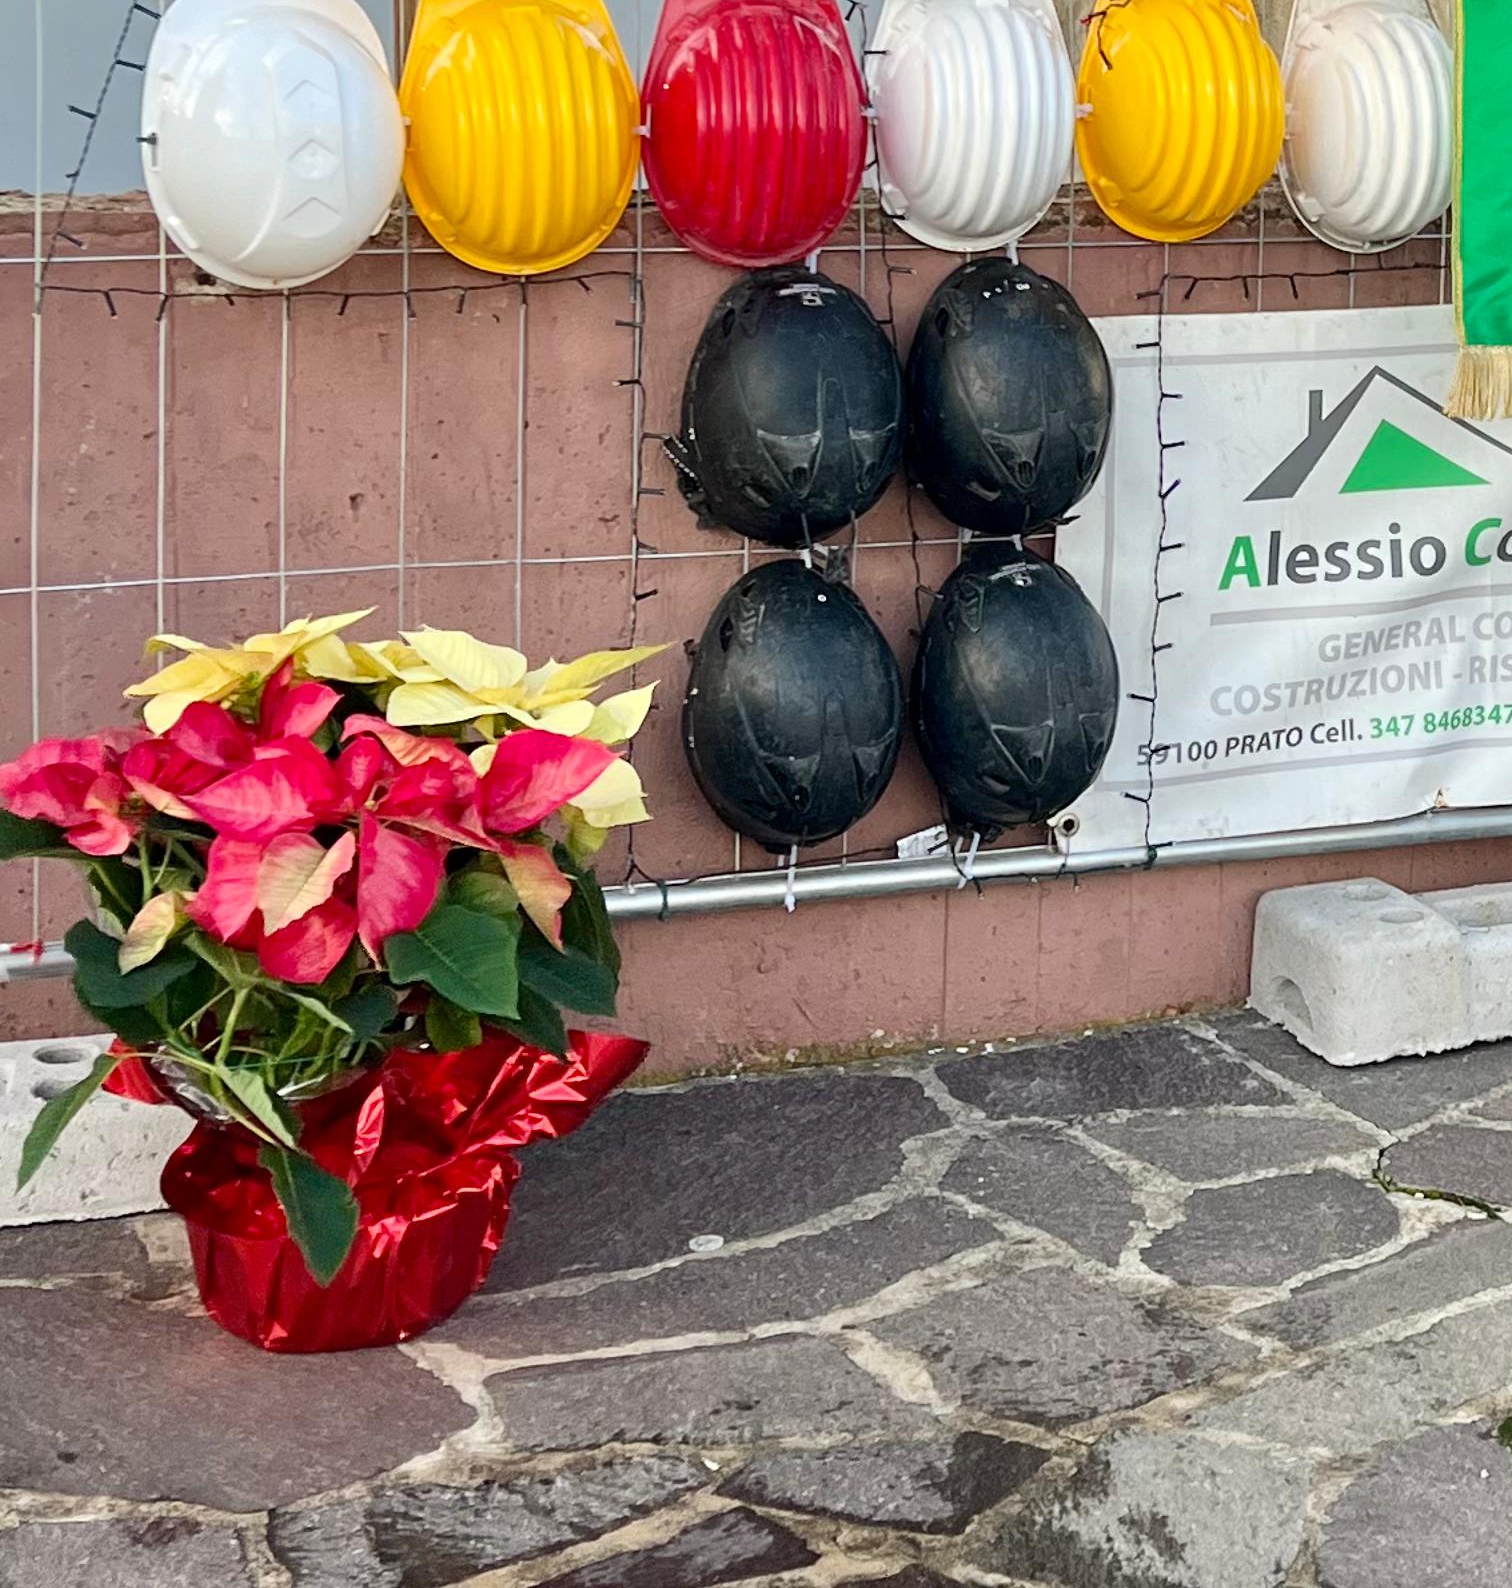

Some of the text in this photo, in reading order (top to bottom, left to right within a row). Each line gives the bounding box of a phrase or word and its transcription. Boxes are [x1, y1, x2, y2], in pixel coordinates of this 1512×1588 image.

[1218, 522, 1447, 591] Alessio
[1317, 615, 1466, 663] GENERAL
[1210, 661, 1443, 716] COSTRUZIONI
[1136, 740, 1218, 766] 59100
[1224, 725, 1303, 758] PRATO
[1310, 718, 1363, 745] Cell.
[1369, 714, 1415, 740] 347
